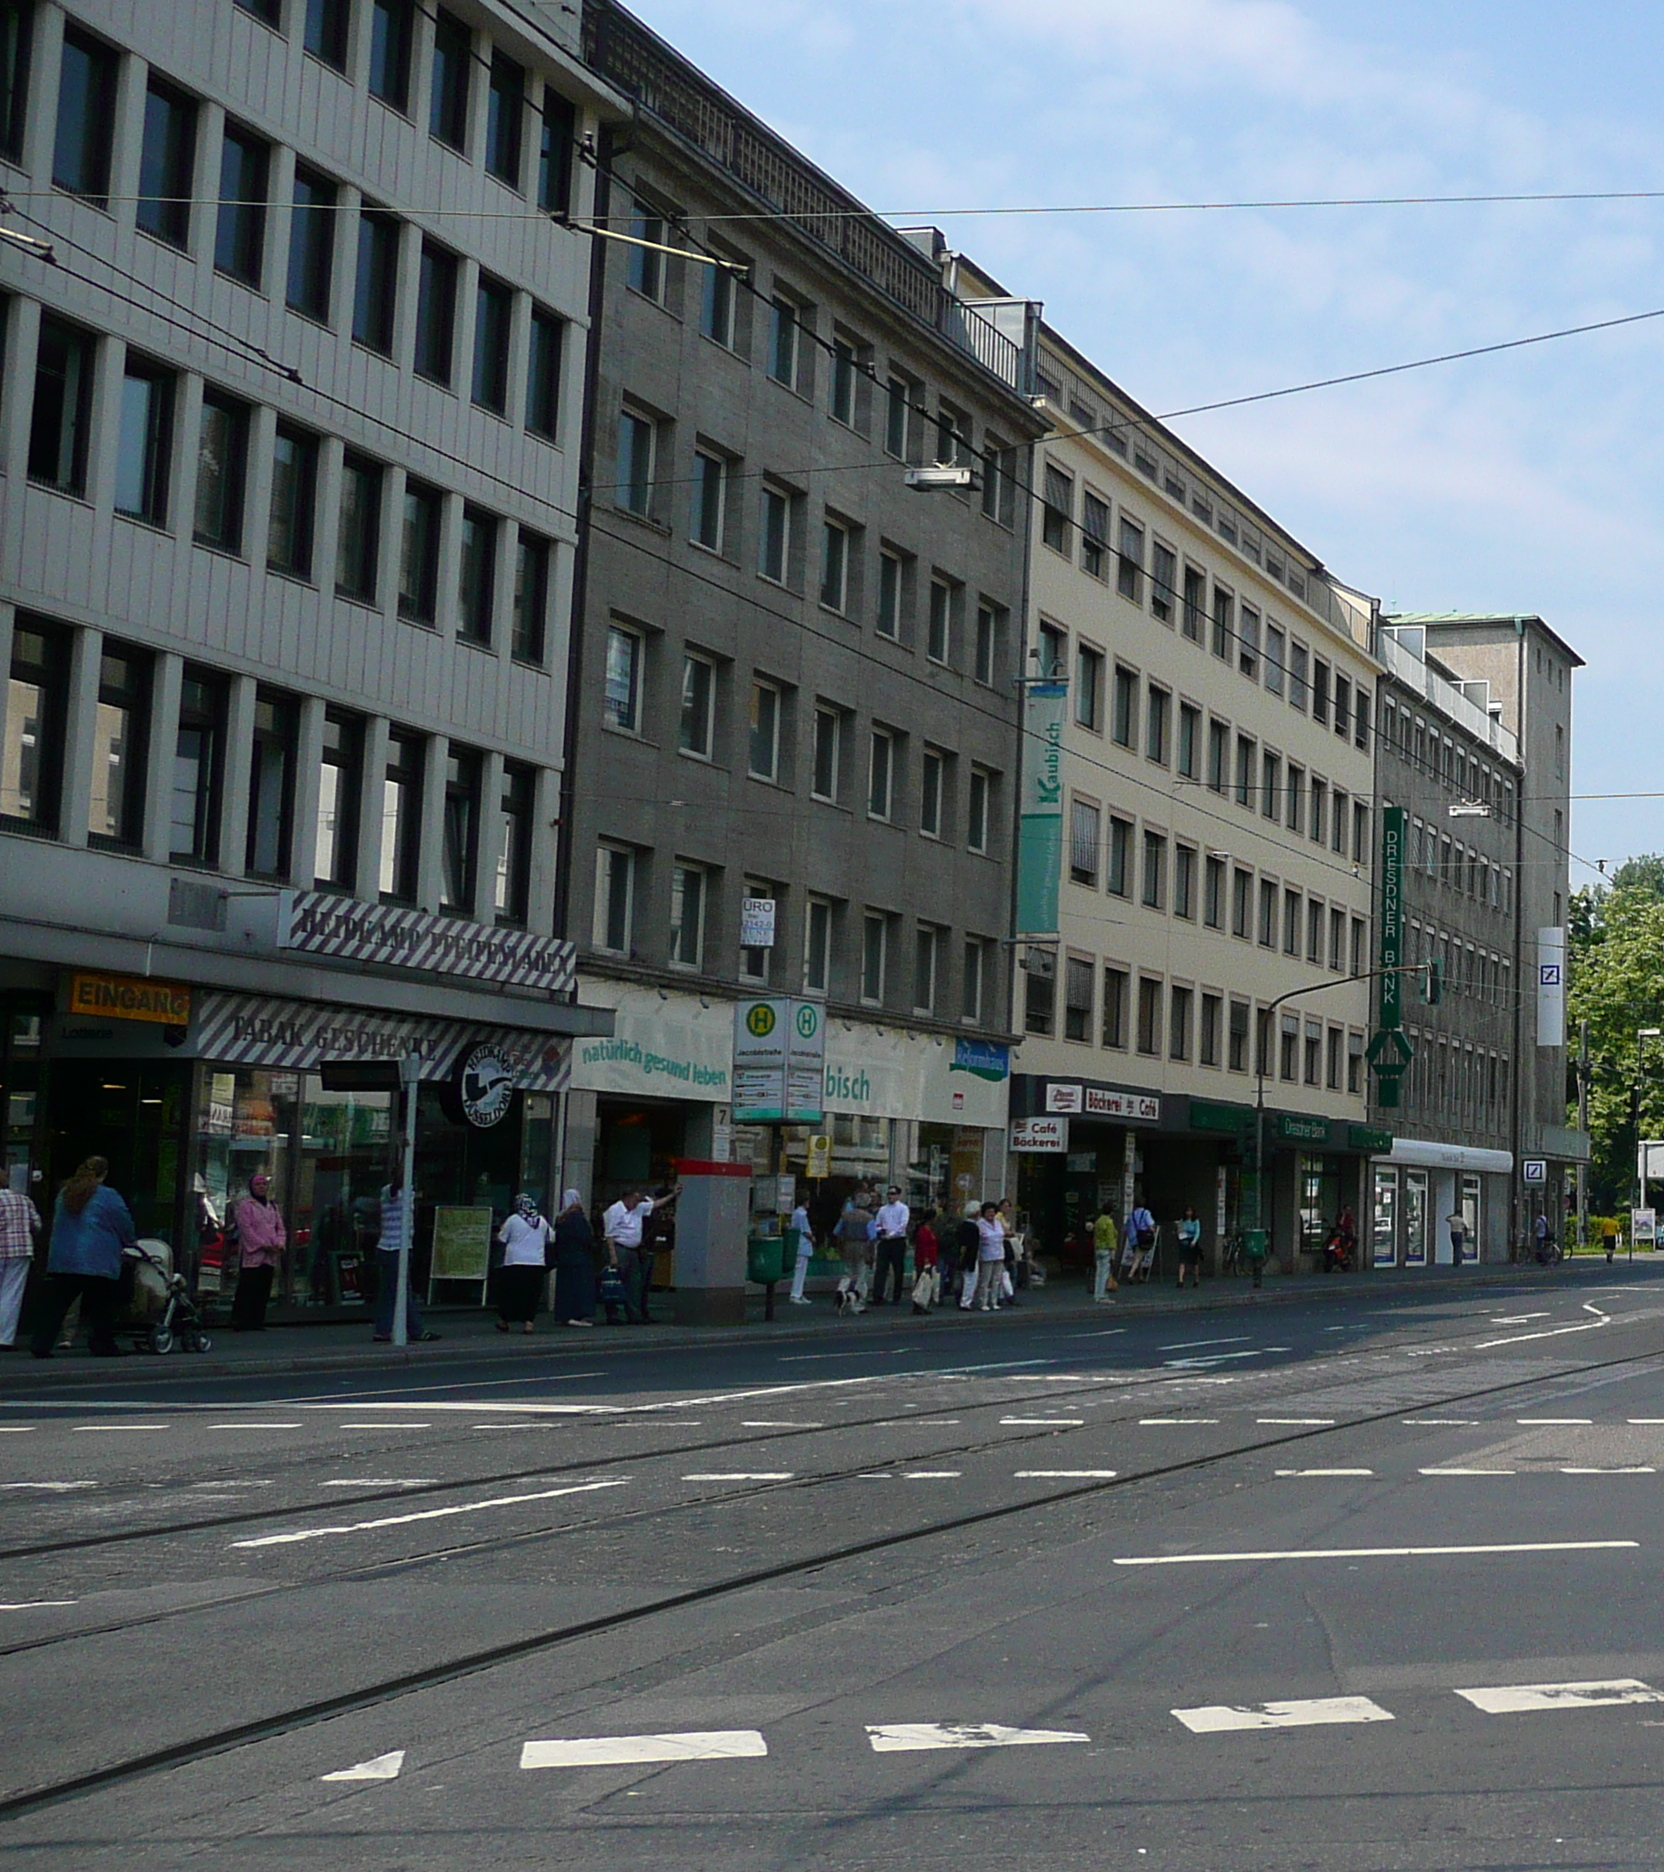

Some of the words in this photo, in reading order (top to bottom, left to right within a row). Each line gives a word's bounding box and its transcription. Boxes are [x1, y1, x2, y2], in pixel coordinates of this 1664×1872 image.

[1036, 721, 1061, 804] Kaubisch
[1385, 831, 1398, 938] DRESDNER
[78, 980, 190, 1017] EINGANG
[232, 1015, 305, 1048] TABAK
[315, 1026, 437, 1061] GESCHENKE
[582, 1038, 642, 1064] natürlich
[643, 1052, 691, 1081] gesund
[692, 1063, 727, 1086] leben
[825, 1064, 870, 1101] bisch
[719, 1109, 727, 1125] 7
[1088, 1090, 1122, 1112] Bäckerei
[1139, 1098, 1157, 1118] Café
[1013, 1136, 1060, 1147] Bäckerei
[1031, 1122, 1057, 1134] Café
